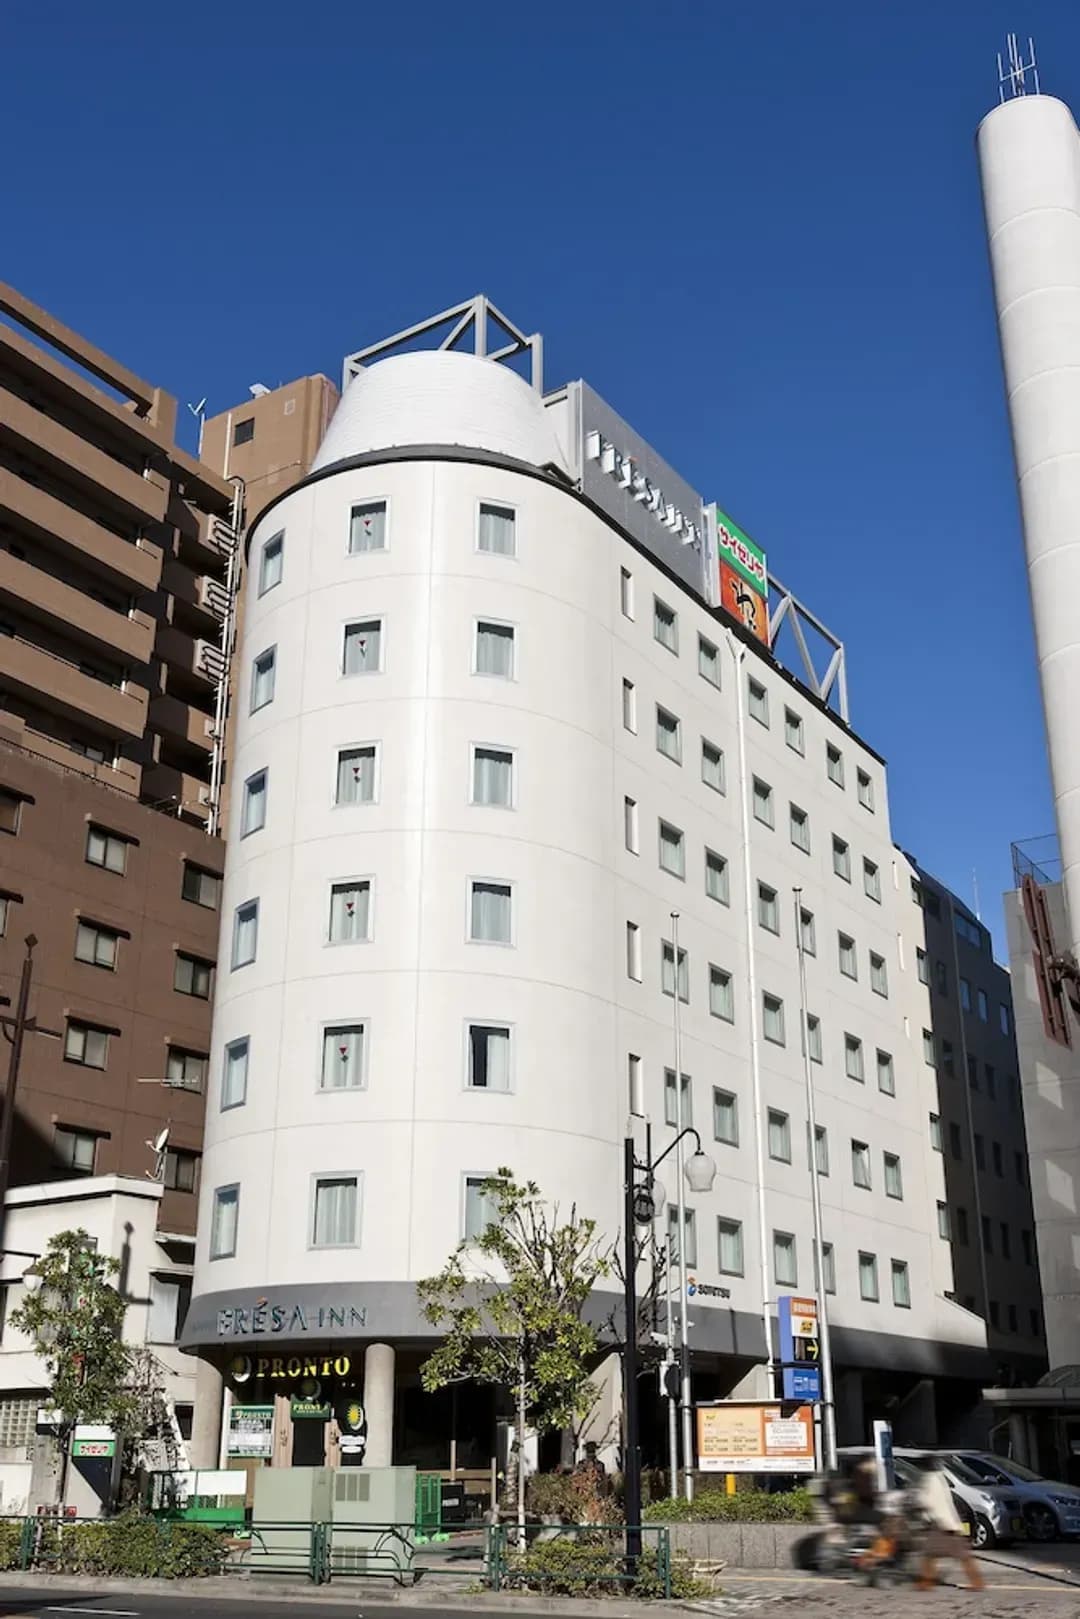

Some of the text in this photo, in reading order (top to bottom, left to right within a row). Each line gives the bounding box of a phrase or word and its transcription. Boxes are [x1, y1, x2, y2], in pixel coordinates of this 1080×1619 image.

[217, 1296, 307, 1337] FRÉSA
[318, 1306, 368, 1329] INN
[256, 1356, 351, 1378] PRONTO
